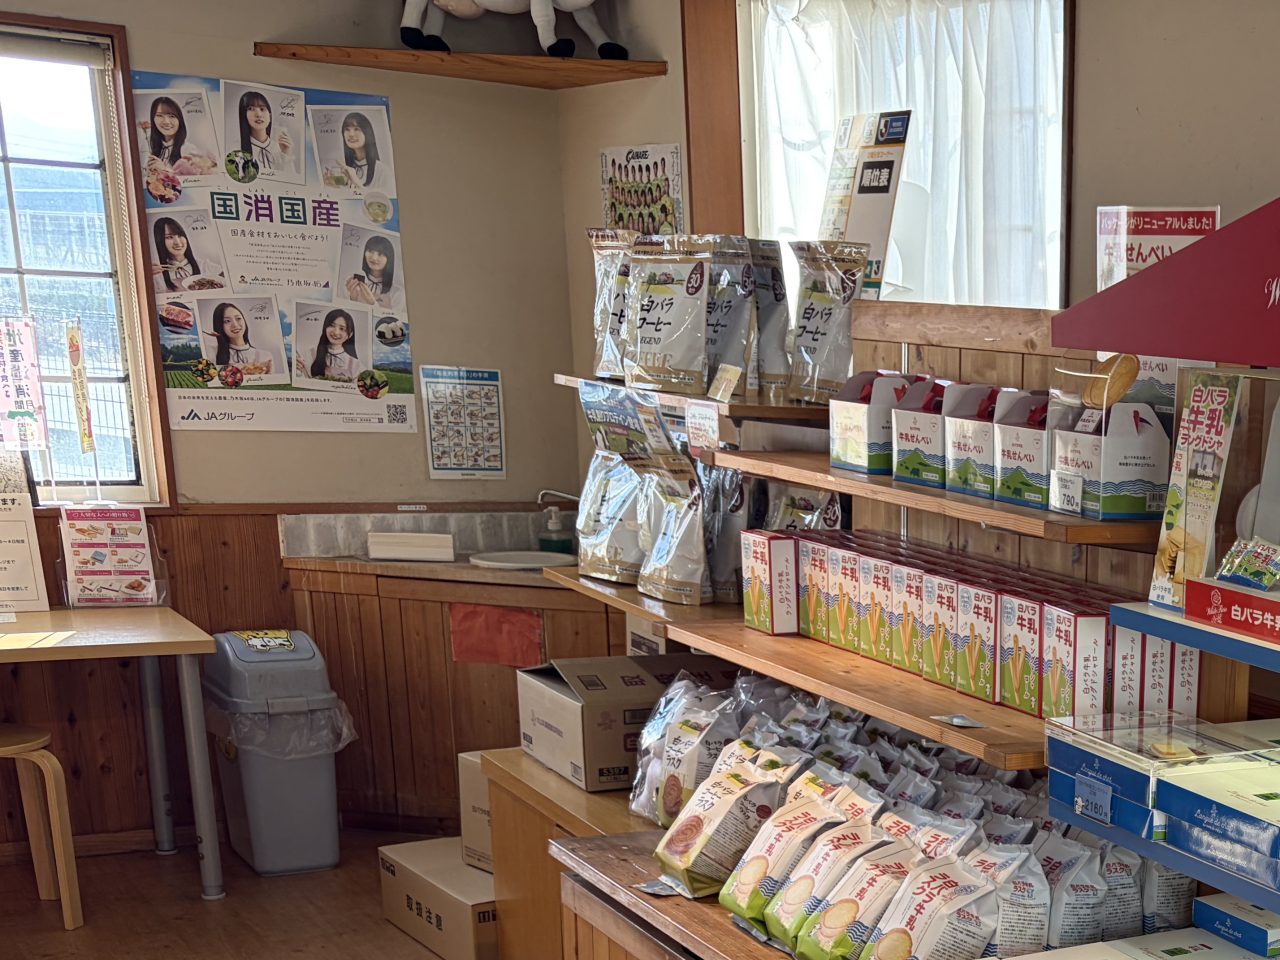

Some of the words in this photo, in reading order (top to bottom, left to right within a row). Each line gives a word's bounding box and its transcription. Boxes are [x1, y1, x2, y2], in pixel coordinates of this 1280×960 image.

[861, 168, 890, 187] 順位表
[210, 191, 341, 228] 国消国産
[1100, 215, 1213, 231] パッケージがリニューアルしました!
[801, 303, 833, 321] 白バラ
[1192, 386, 1228, 406] 白バラ
[203, 412, 255, 421] JAグループ
[1188, 408, 1225, 437] 牛乳
[899, 431, 933, 446] 牛乳せんべい
[1180, 432, 1223, 451] ラングドシャ
[952, 441, 984, 455] 牛乳せんべい
[1000, 449, 1035, 464] 牛乳せんべい
[1057, 454, 1093, 471] 牛乳せんべい
[752, 539, 767, 550] 白バラ
[752, 551, 768, 565] 牛乳
[811, 547, 826, 558] 白バラ
[811, 558, 827, 573] 牛乳
[841, 555, 858, 566] 白バラ
[841, 566, 859, 582] 牛乳
[873, 563, 890, 575] 白バラ
[873, 575, 891, 592] 牛乳
[906, 572, 923, 584] 白バラ
[906, 584, 923, 600] 牛乳
[937, 582, 955, 594] 白バラ
[937, 594, 956, 612] 牛乳
[974, 592, 993, 604] 白バラ
[973, 604, 994, 624] 牛乳
[1017, 603, 1037, 616] 白バラ
[1017, 615, 1038, 635] 牛乳
[1055, 614, 1073, 627] 白バラ
[1055, 626, 1073, 647] 牛乳
[697, 798, 715, 813] ラスク
[405, 893, 444, 932] 取扱注意
